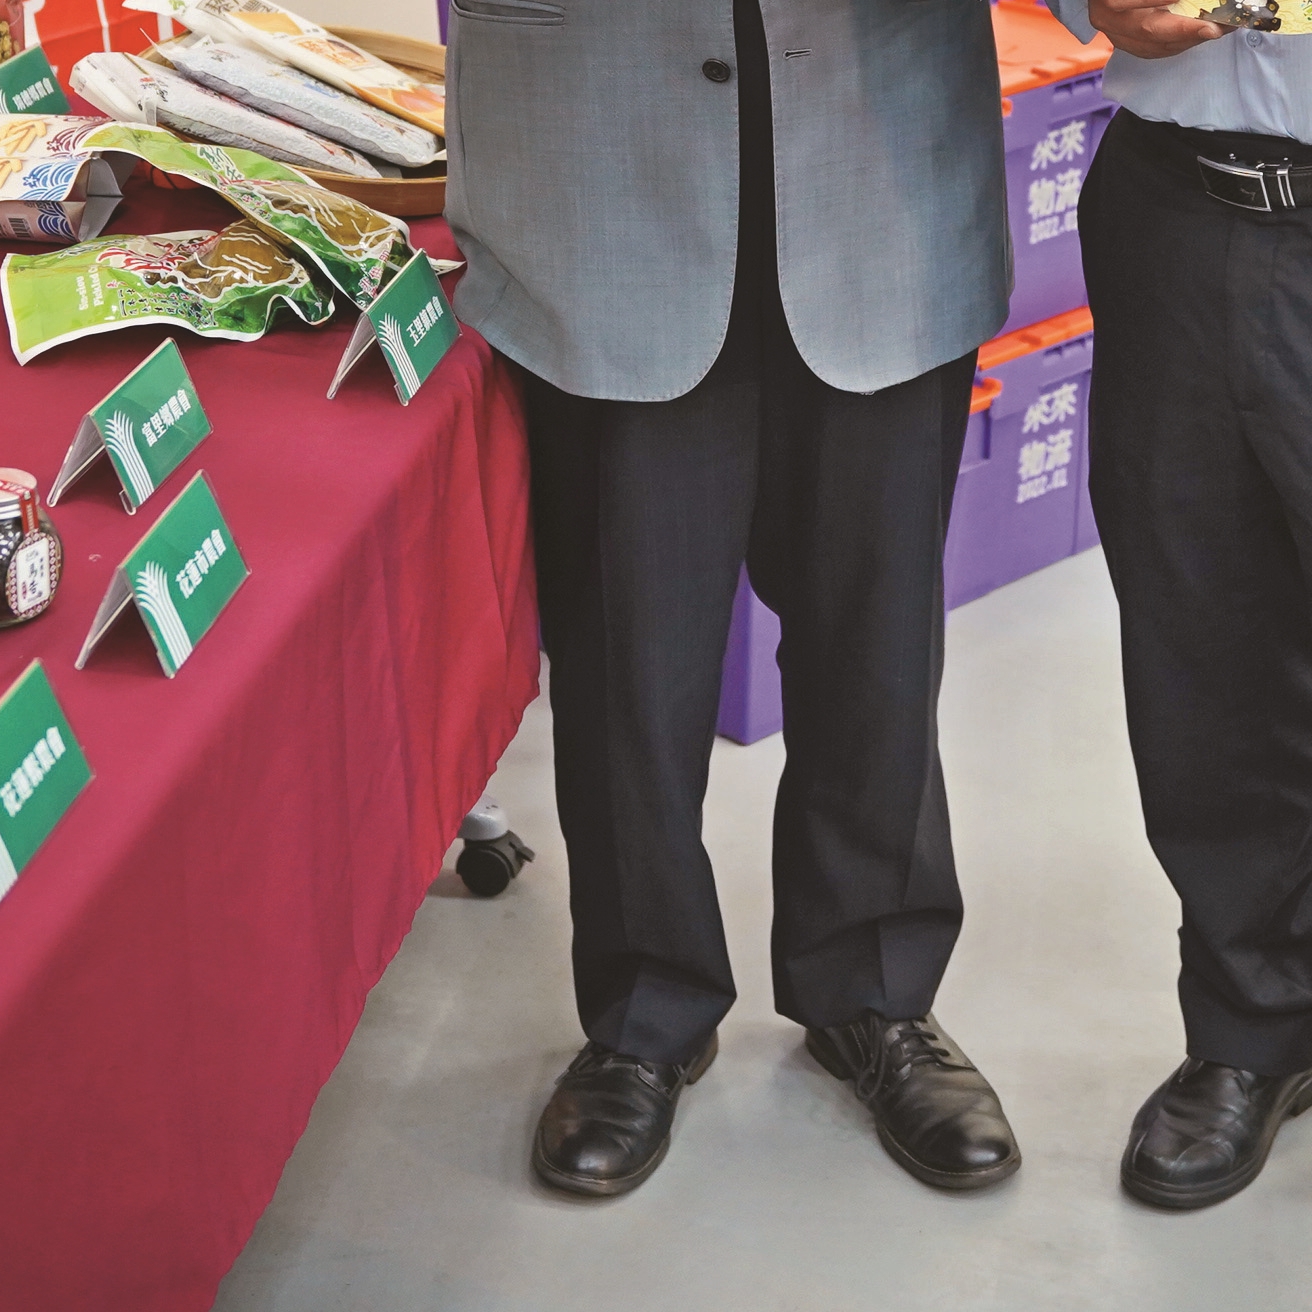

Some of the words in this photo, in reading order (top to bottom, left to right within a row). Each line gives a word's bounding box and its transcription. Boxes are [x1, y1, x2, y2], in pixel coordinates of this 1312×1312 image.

[1030, 120, 1086, 170] 未來
[404, 296, 444, 347] 玉里鎮農會
[141, 389, 192, 448] 富里鄉農會
[175, 529, 227, 600] 花蓮市農會
